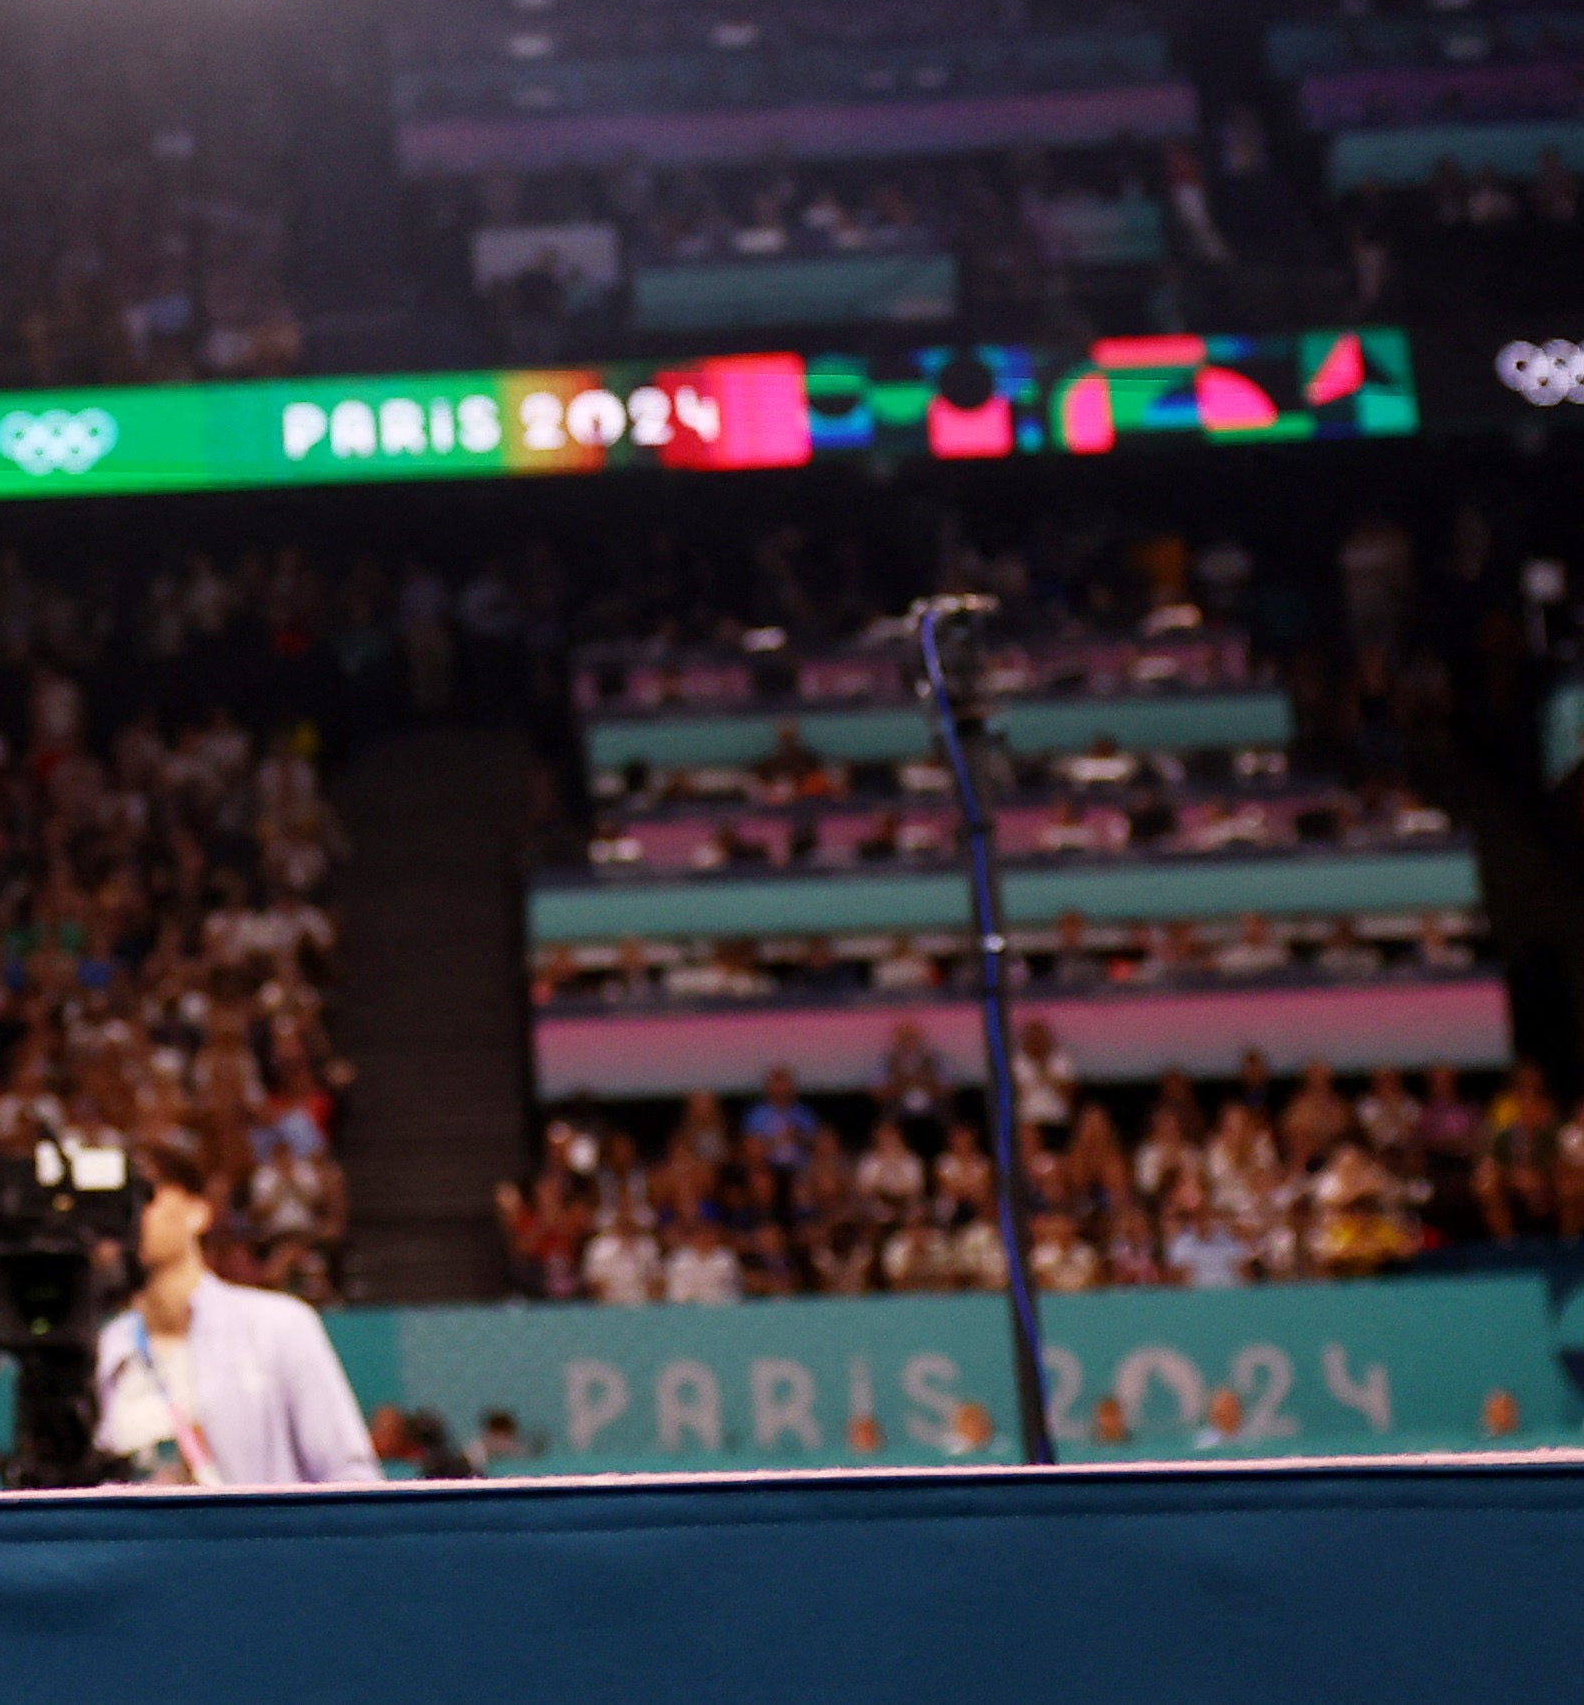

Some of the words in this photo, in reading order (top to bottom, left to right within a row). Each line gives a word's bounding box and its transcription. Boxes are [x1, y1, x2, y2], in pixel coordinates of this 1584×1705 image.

[282, 394, 500, 461] PARIS
[519, 386, 722, 450] 2024
[563, 1350, 963, 1453] PARIS
[1040, 1340, 1393, 1441] 2024
